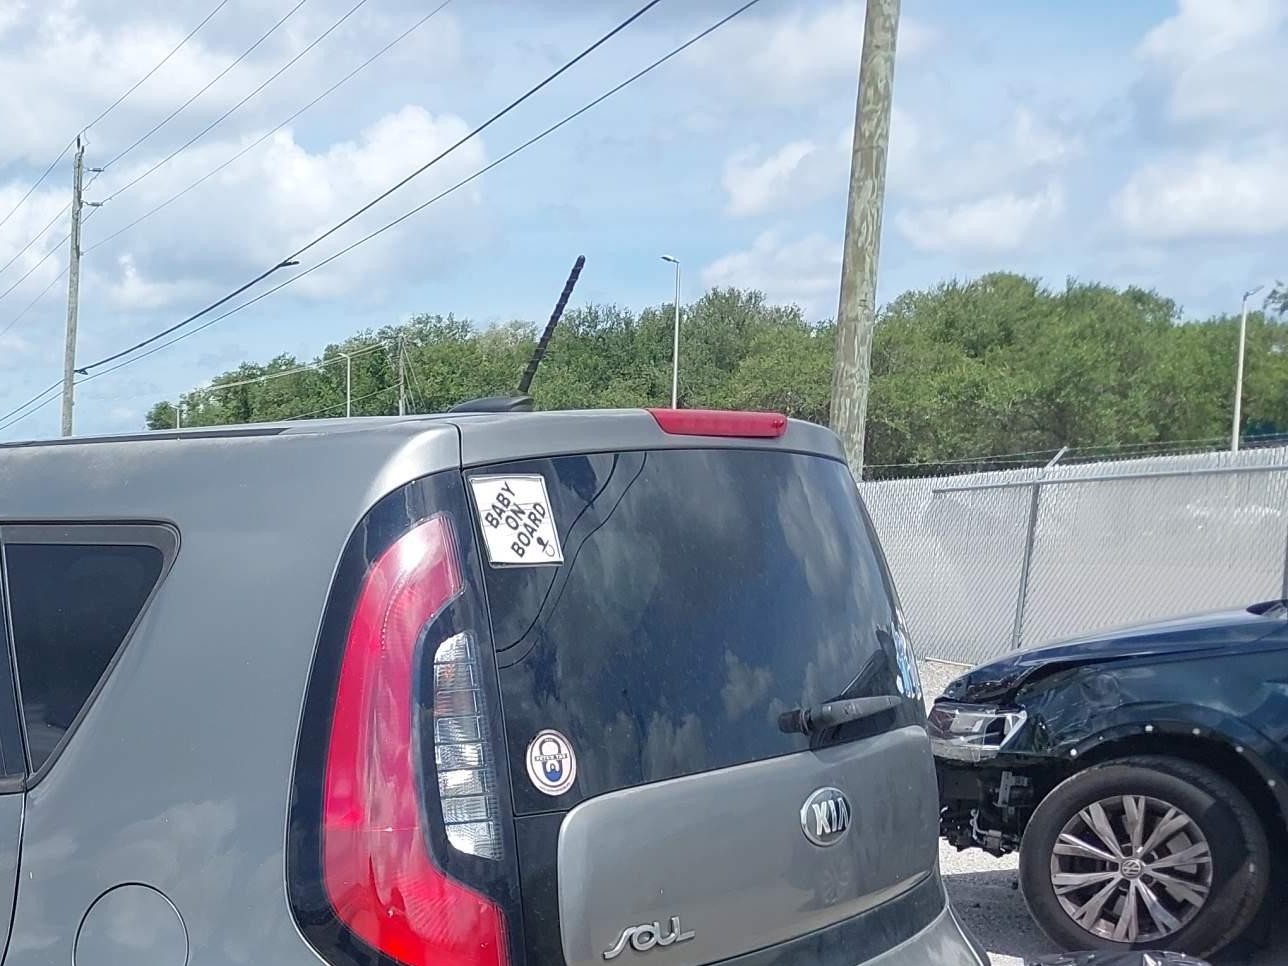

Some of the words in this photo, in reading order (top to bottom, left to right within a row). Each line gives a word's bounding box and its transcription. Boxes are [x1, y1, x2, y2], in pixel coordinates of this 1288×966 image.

[484, 481, 516, 529] BABY
[504, 502, 527, 531] ON
[510, 502, 547, 558] BOARD
[811, 797, 850, 836] KIA
[602, 915, 696, 961] SOUL
